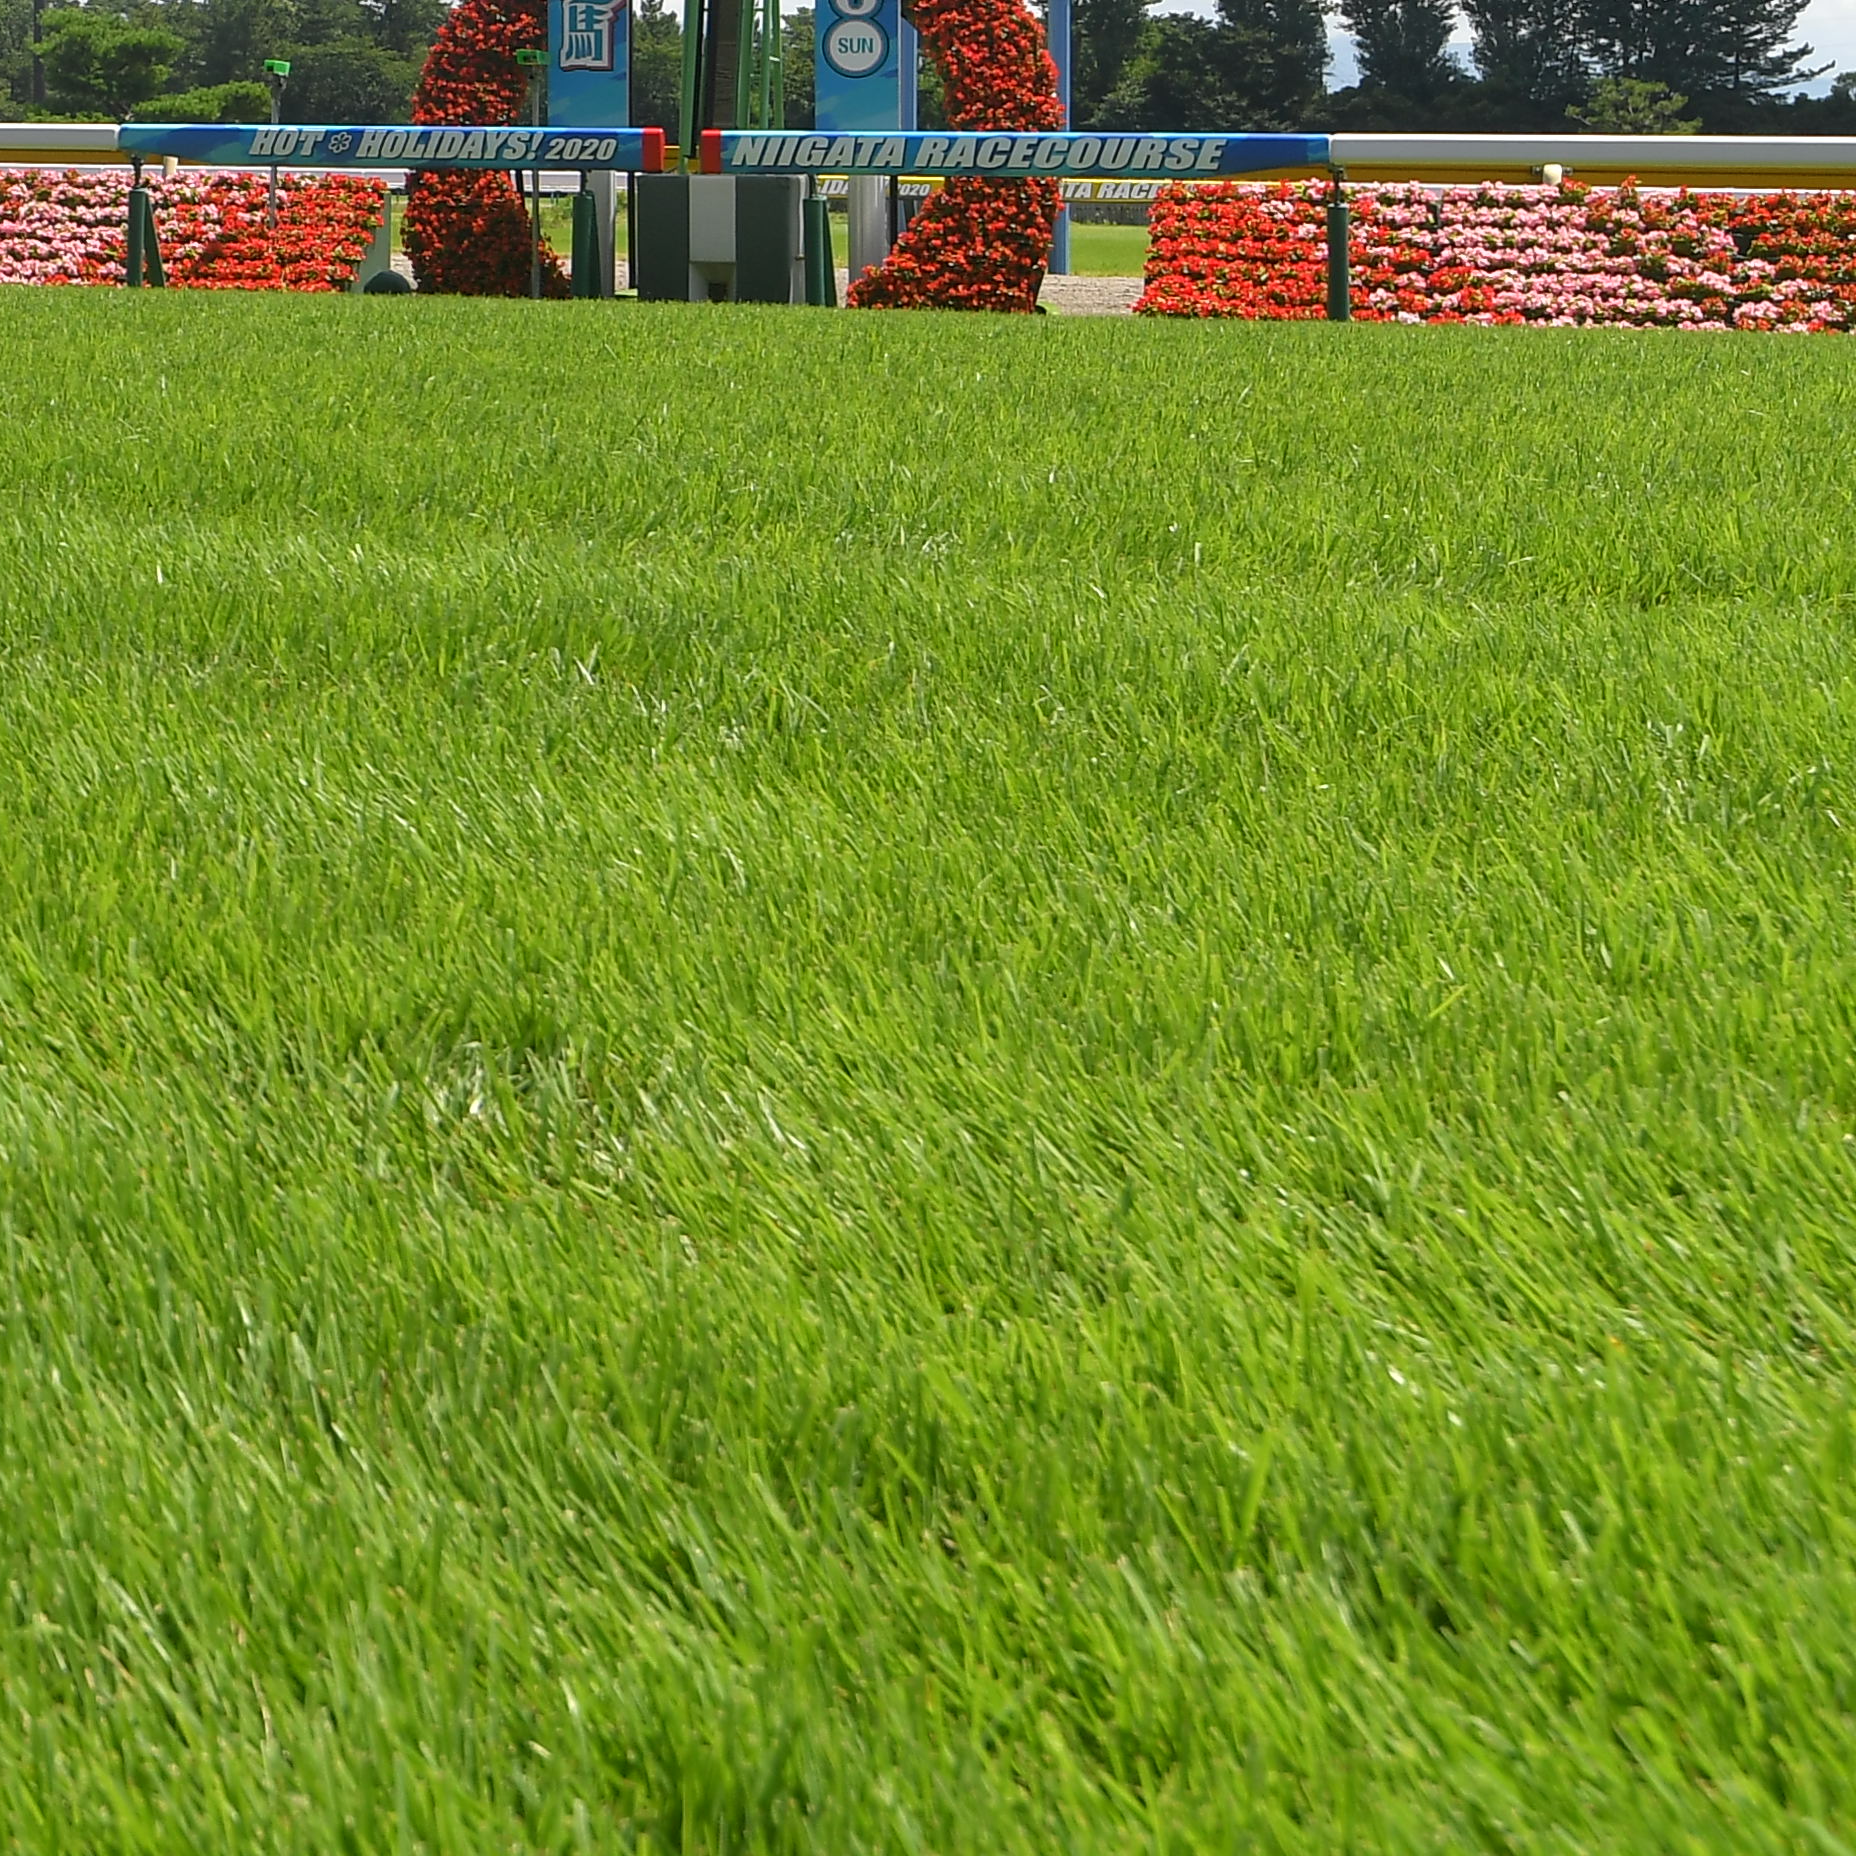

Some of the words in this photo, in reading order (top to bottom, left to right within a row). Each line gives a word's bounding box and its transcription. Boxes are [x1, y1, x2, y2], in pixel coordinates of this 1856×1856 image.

[838, 37, 873, 54] SUN
[249, 127, 327, 156] HOT
[357, 129, 542, 161] HOLIDAYS!
[544, 138, 617, 162] 2020
[731, 136, 908, 169] NIIGATA
[913, 136, 1229, 172] RACECOURSE
[897, 183, 931, 196] 020
